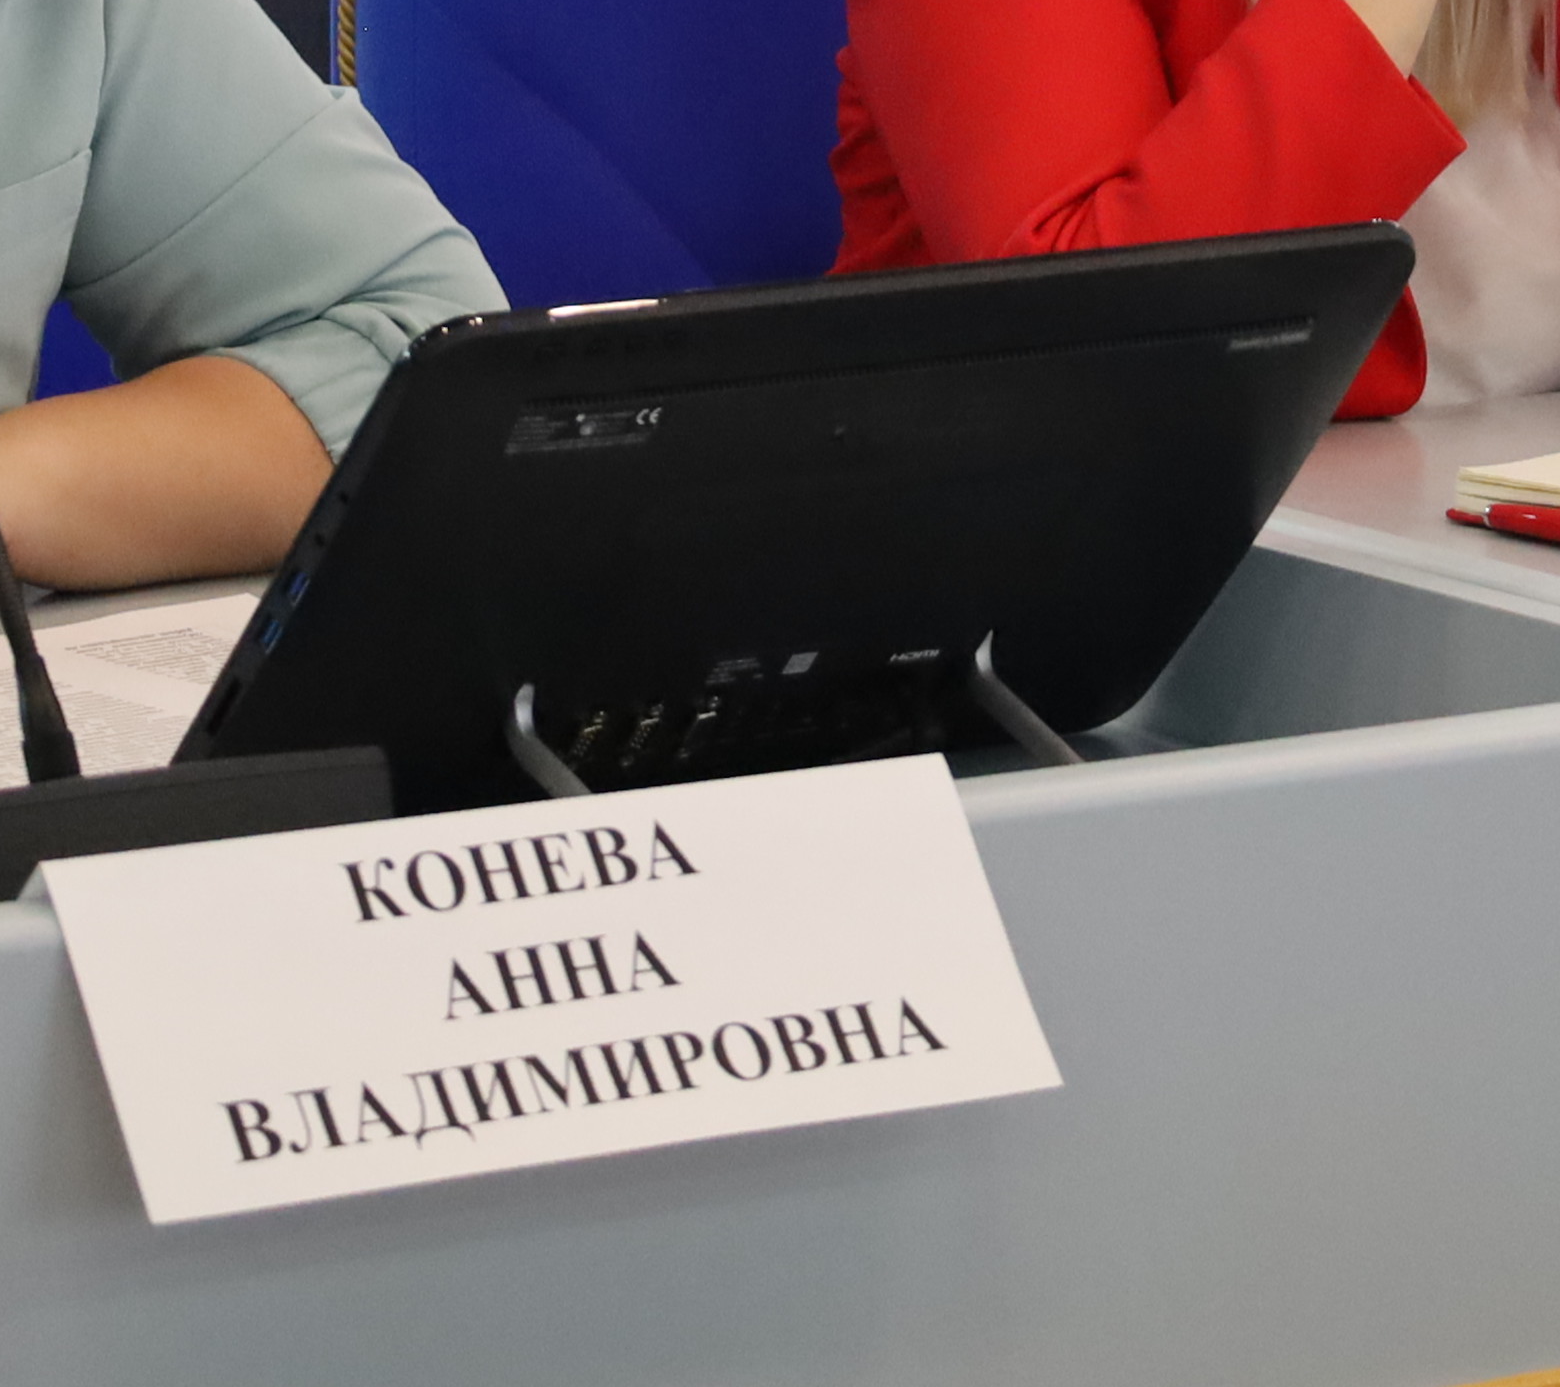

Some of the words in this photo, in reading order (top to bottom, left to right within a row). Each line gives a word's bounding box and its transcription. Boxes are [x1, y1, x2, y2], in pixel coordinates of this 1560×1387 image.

[340, 819, 700, 923] КОНЕВА
[441, 929, 682, 1021] АННА
[217, 996, 948, 1164] ВЛАДИМИРОВНА
